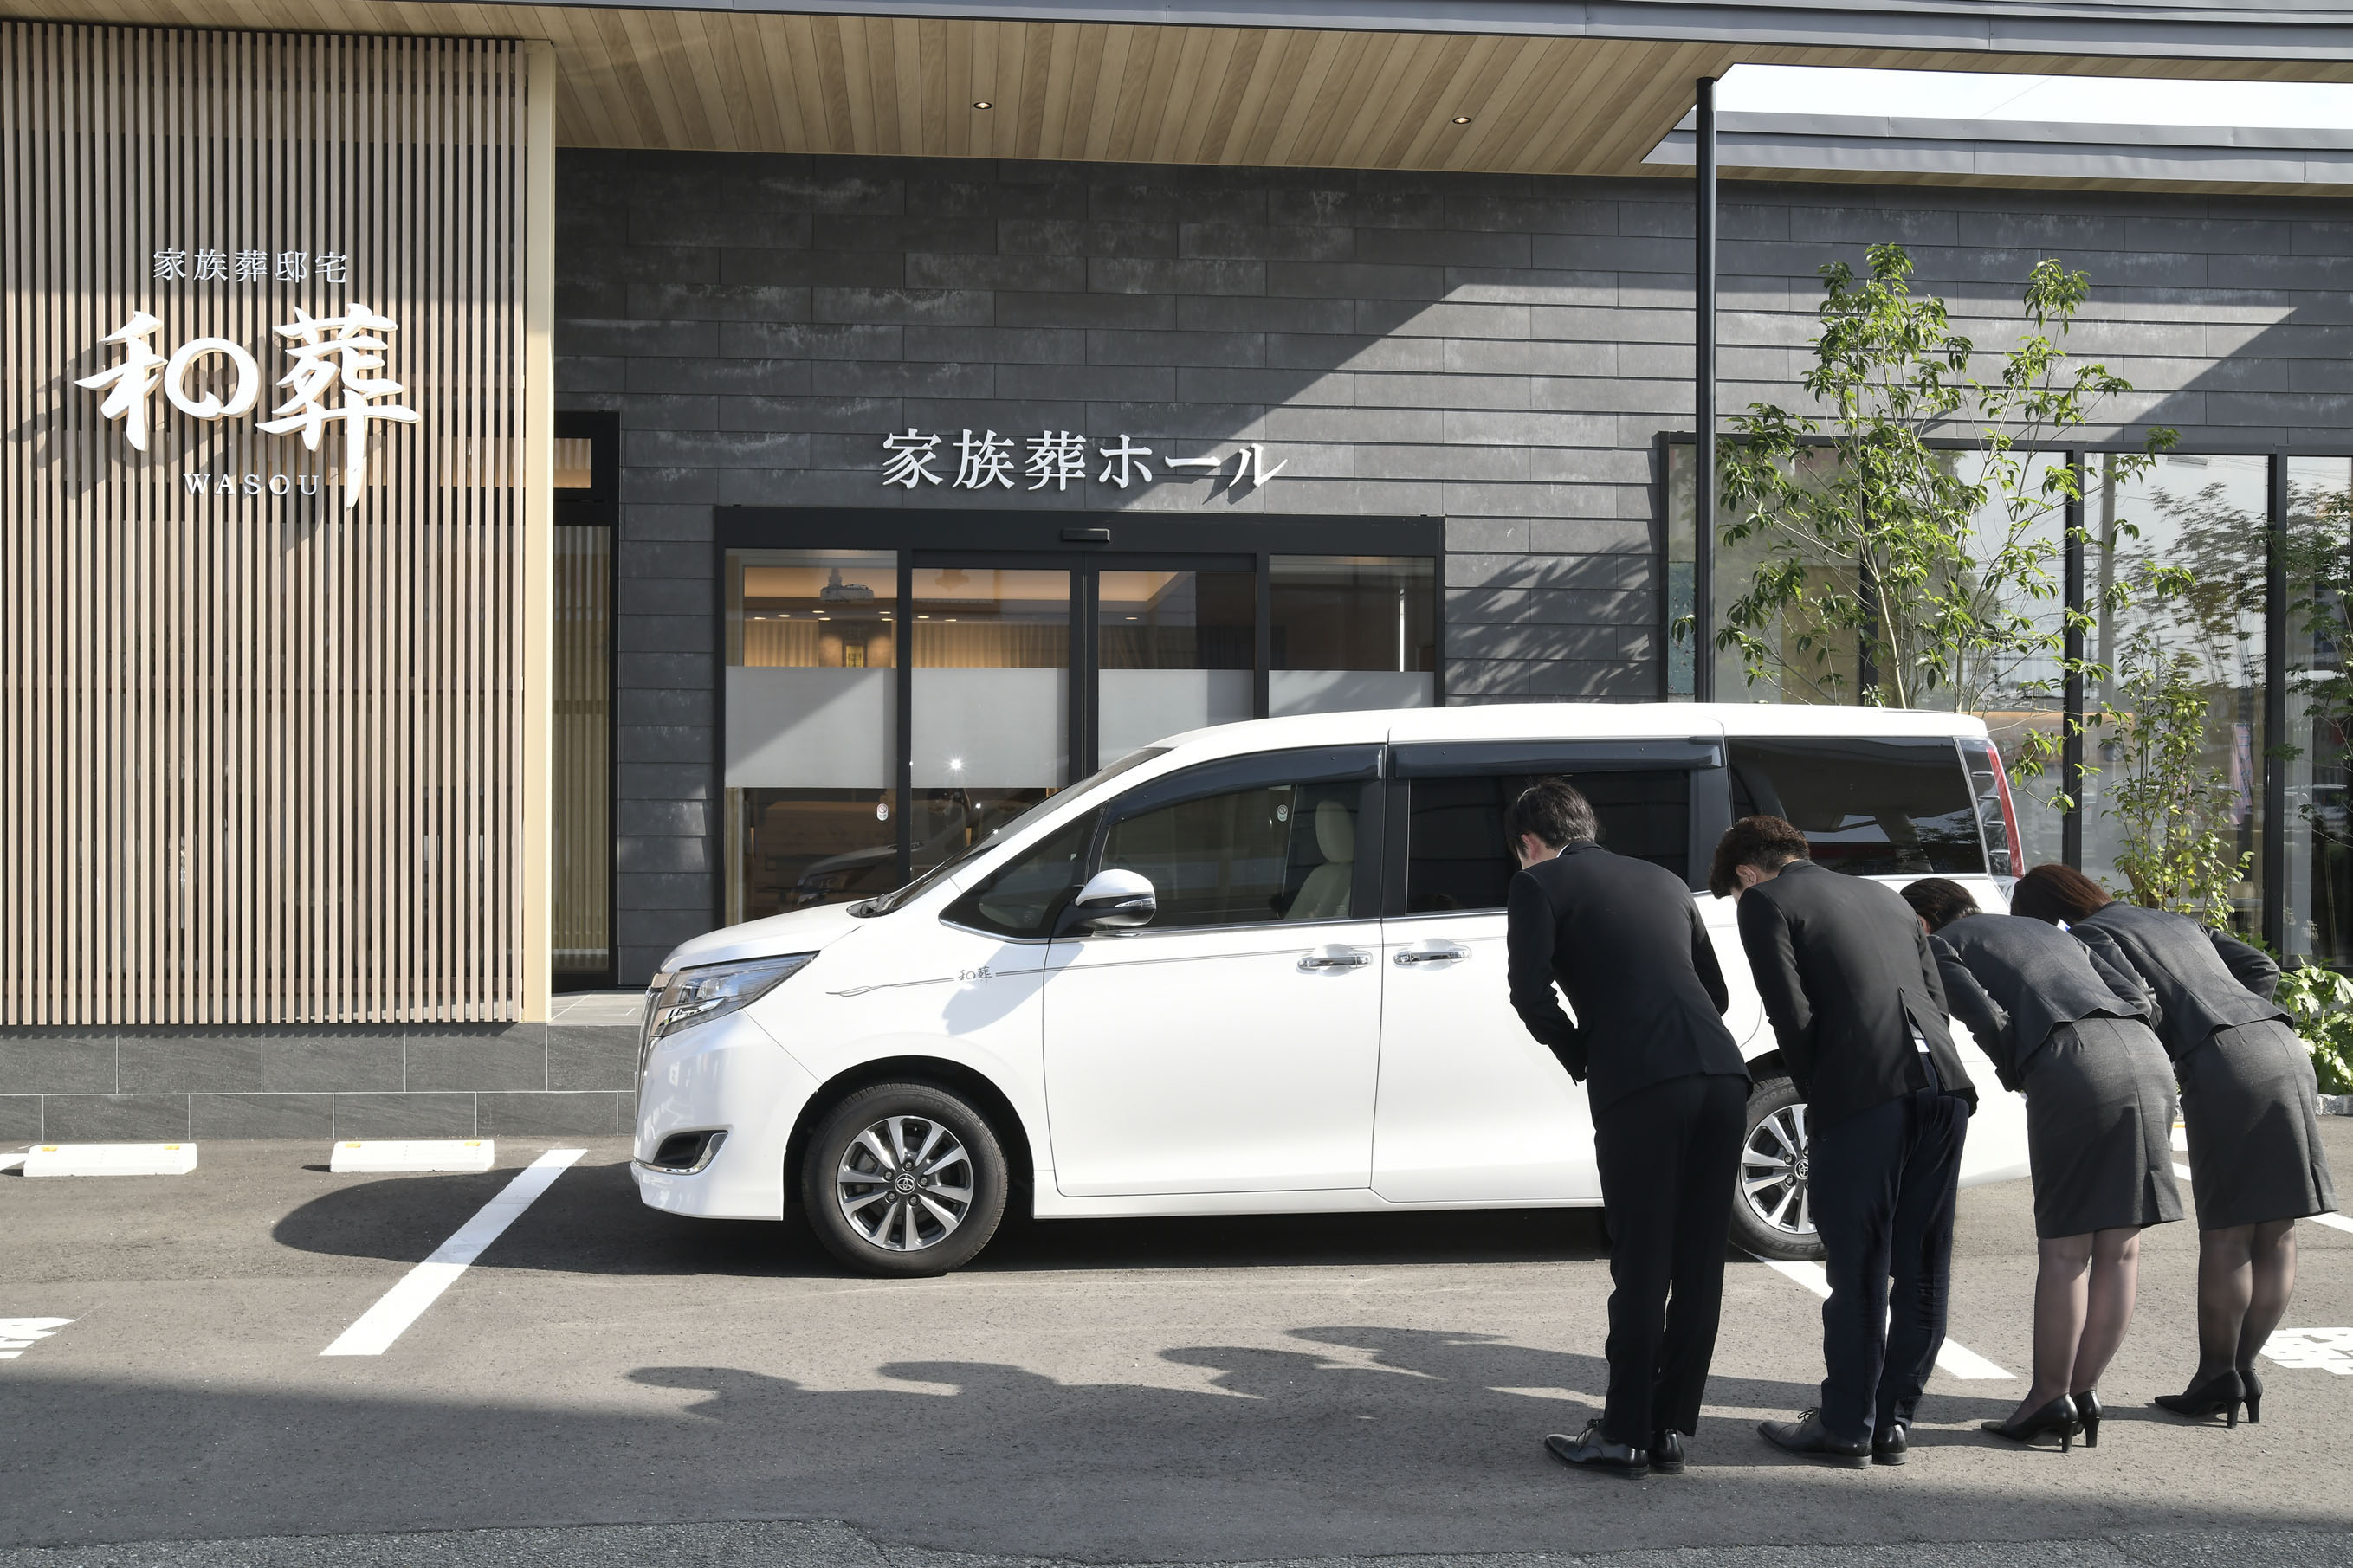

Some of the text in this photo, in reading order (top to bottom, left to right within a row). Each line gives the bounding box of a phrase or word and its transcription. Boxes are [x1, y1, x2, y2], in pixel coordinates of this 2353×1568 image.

[153, 248, 348, 283] 家族葬邸宅
[74, 303, 422, 510] 和葬
[882, 428, 1289, 491] 家族葬ホール
[184, 473, 320, 496] WASOU
